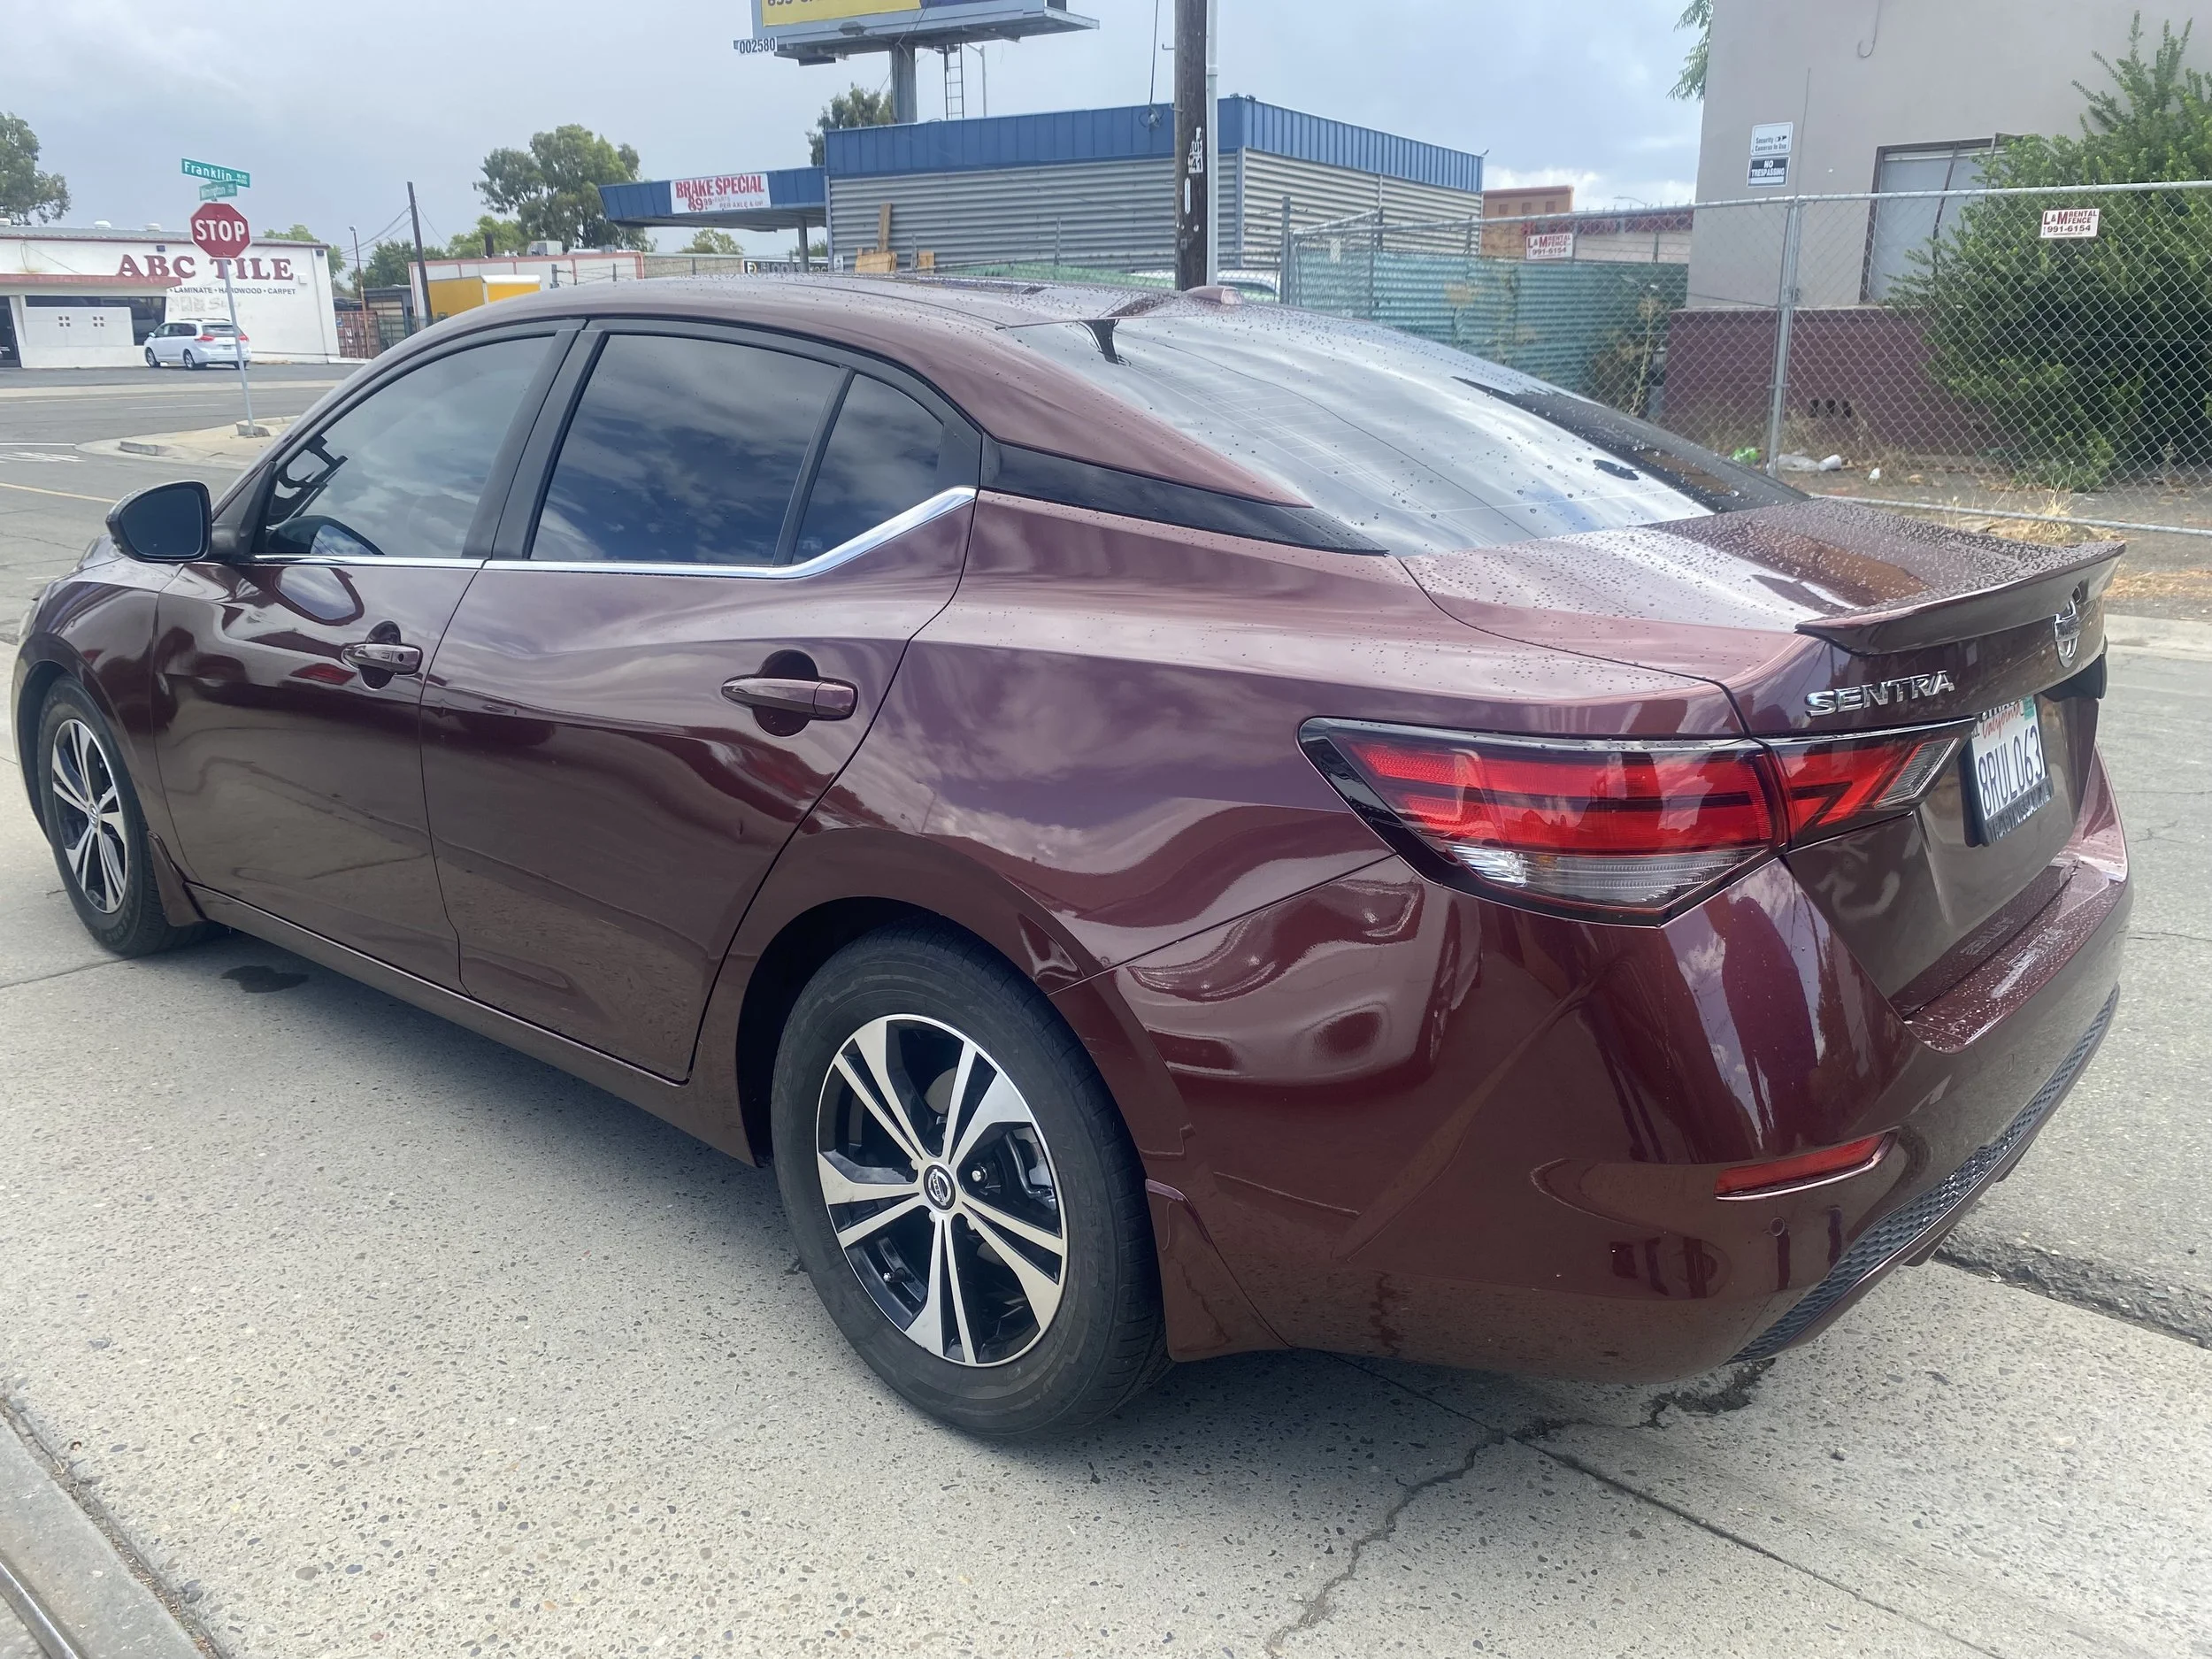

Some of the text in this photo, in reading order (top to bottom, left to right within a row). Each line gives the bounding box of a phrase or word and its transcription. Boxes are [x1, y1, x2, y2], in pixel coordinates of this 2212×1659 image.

[740, 38, 776, 54] 002580
[184, 161, 232, 181] Franklin
[1751, 167, 1786, 178] TRESPASSING
[1763, 159, 1774, 169] NO
[675, 174, 764, 198] BRAKE SPECIAL
[195, 219, 246, 242] STOP
[2067, 216, 2093, 225] FENCE
[116, 254, 294, 280] ABC TILE
[1804, 670, 1955, 718] SENTRA
[1978, 725, 2044, 818] 8RUL063
